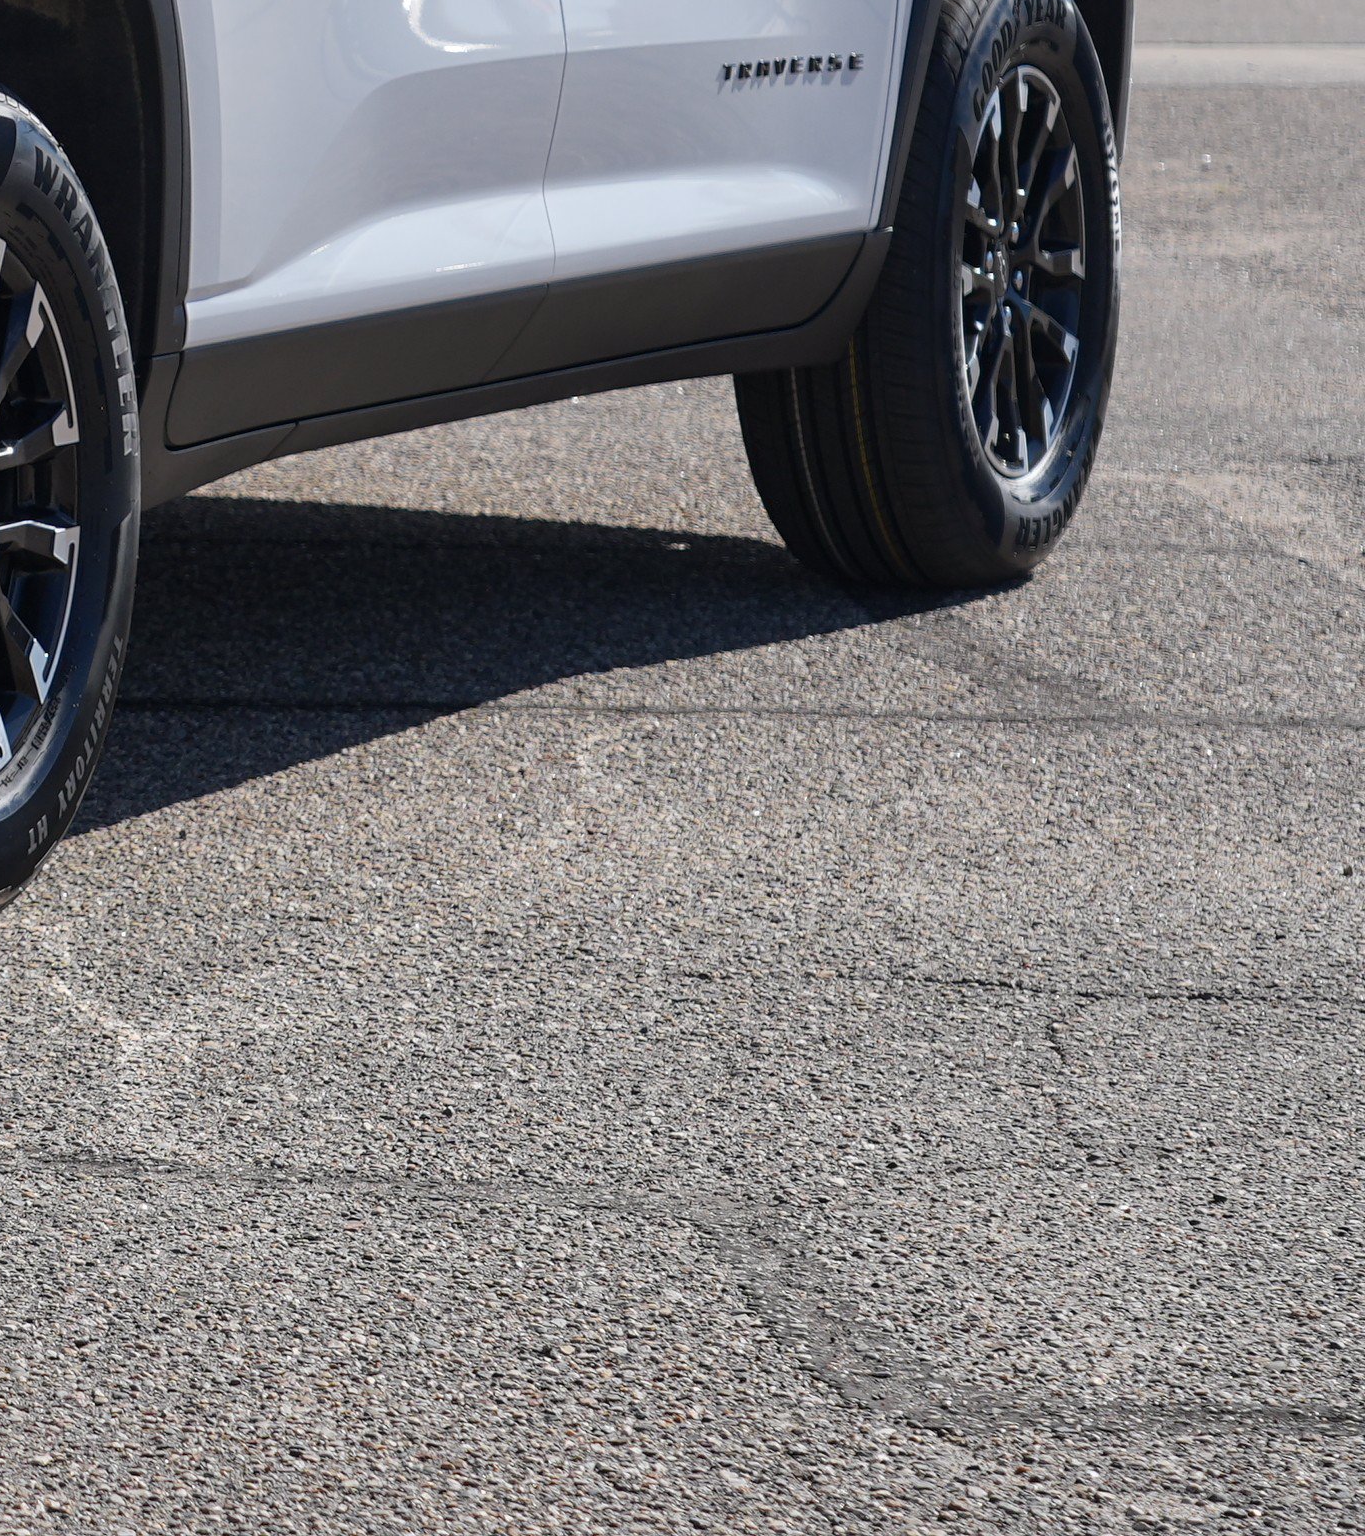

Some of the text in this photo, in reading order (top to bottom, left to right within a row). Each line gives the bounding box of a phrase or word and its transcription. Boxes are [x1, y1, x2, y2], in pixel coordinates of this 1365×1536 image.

[722, 51, 865, 82] TRAVERSE
[32, 145, 141, 458] WRANGLER
[27, 633, 124, 855] TERRITORY HT
